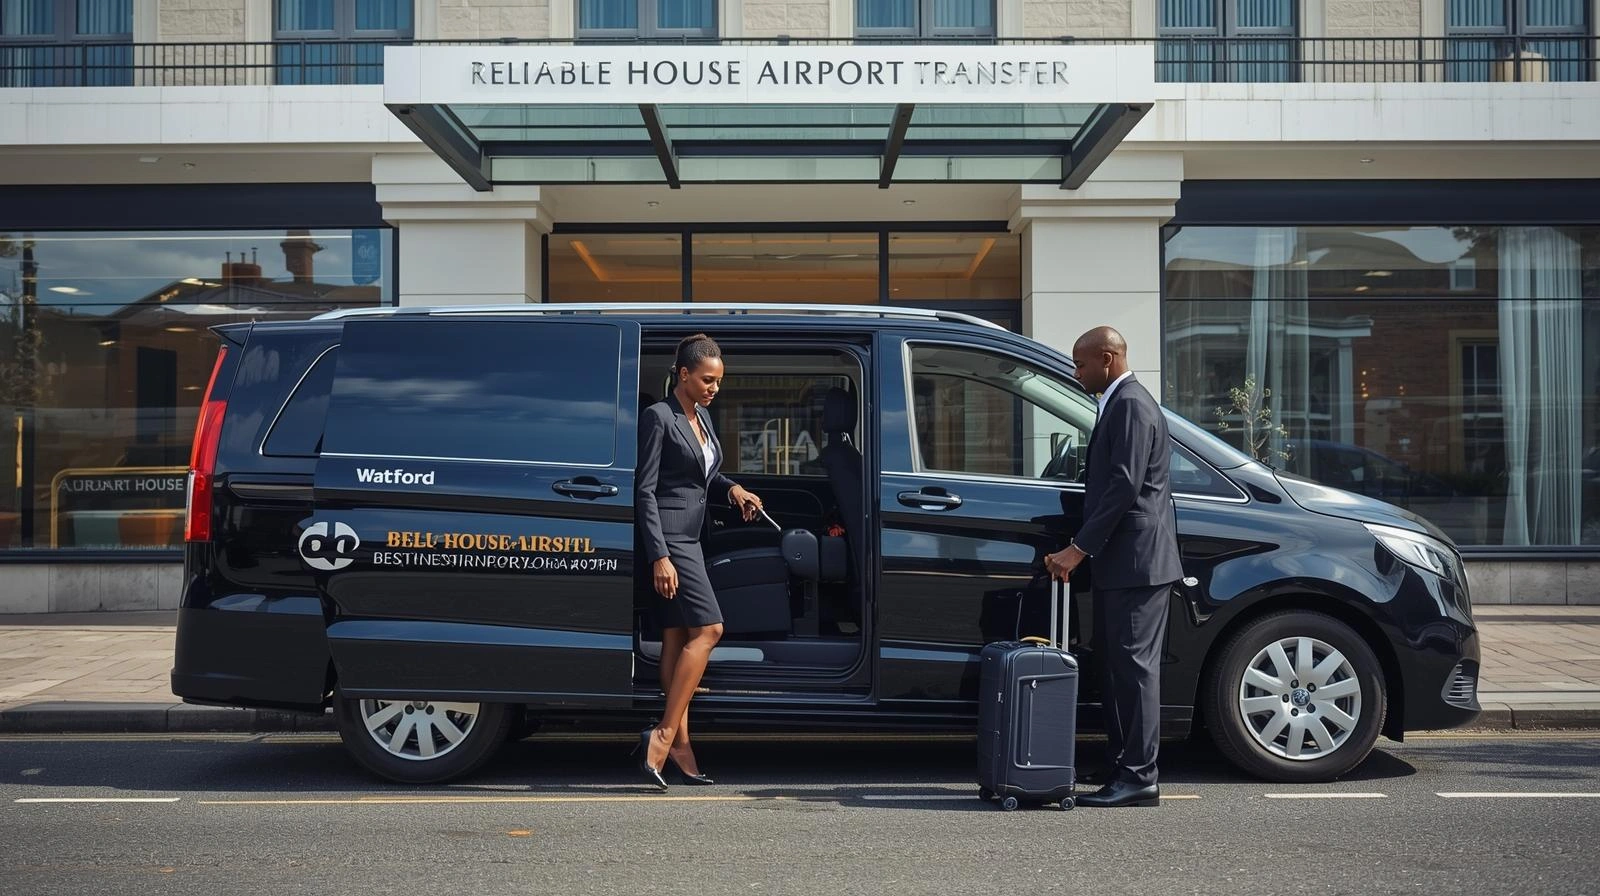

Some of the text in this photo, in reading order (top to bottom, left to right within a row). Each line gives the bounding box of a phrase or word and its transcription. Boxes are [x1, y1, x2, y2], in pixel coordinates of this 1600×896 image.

[471, 60, 1070, 86] RELIABLE HOUSE AIRPORT TRANSFER
[135, 479, 184, 491] HOUSE
[356, 468, 435, 485] Watford
